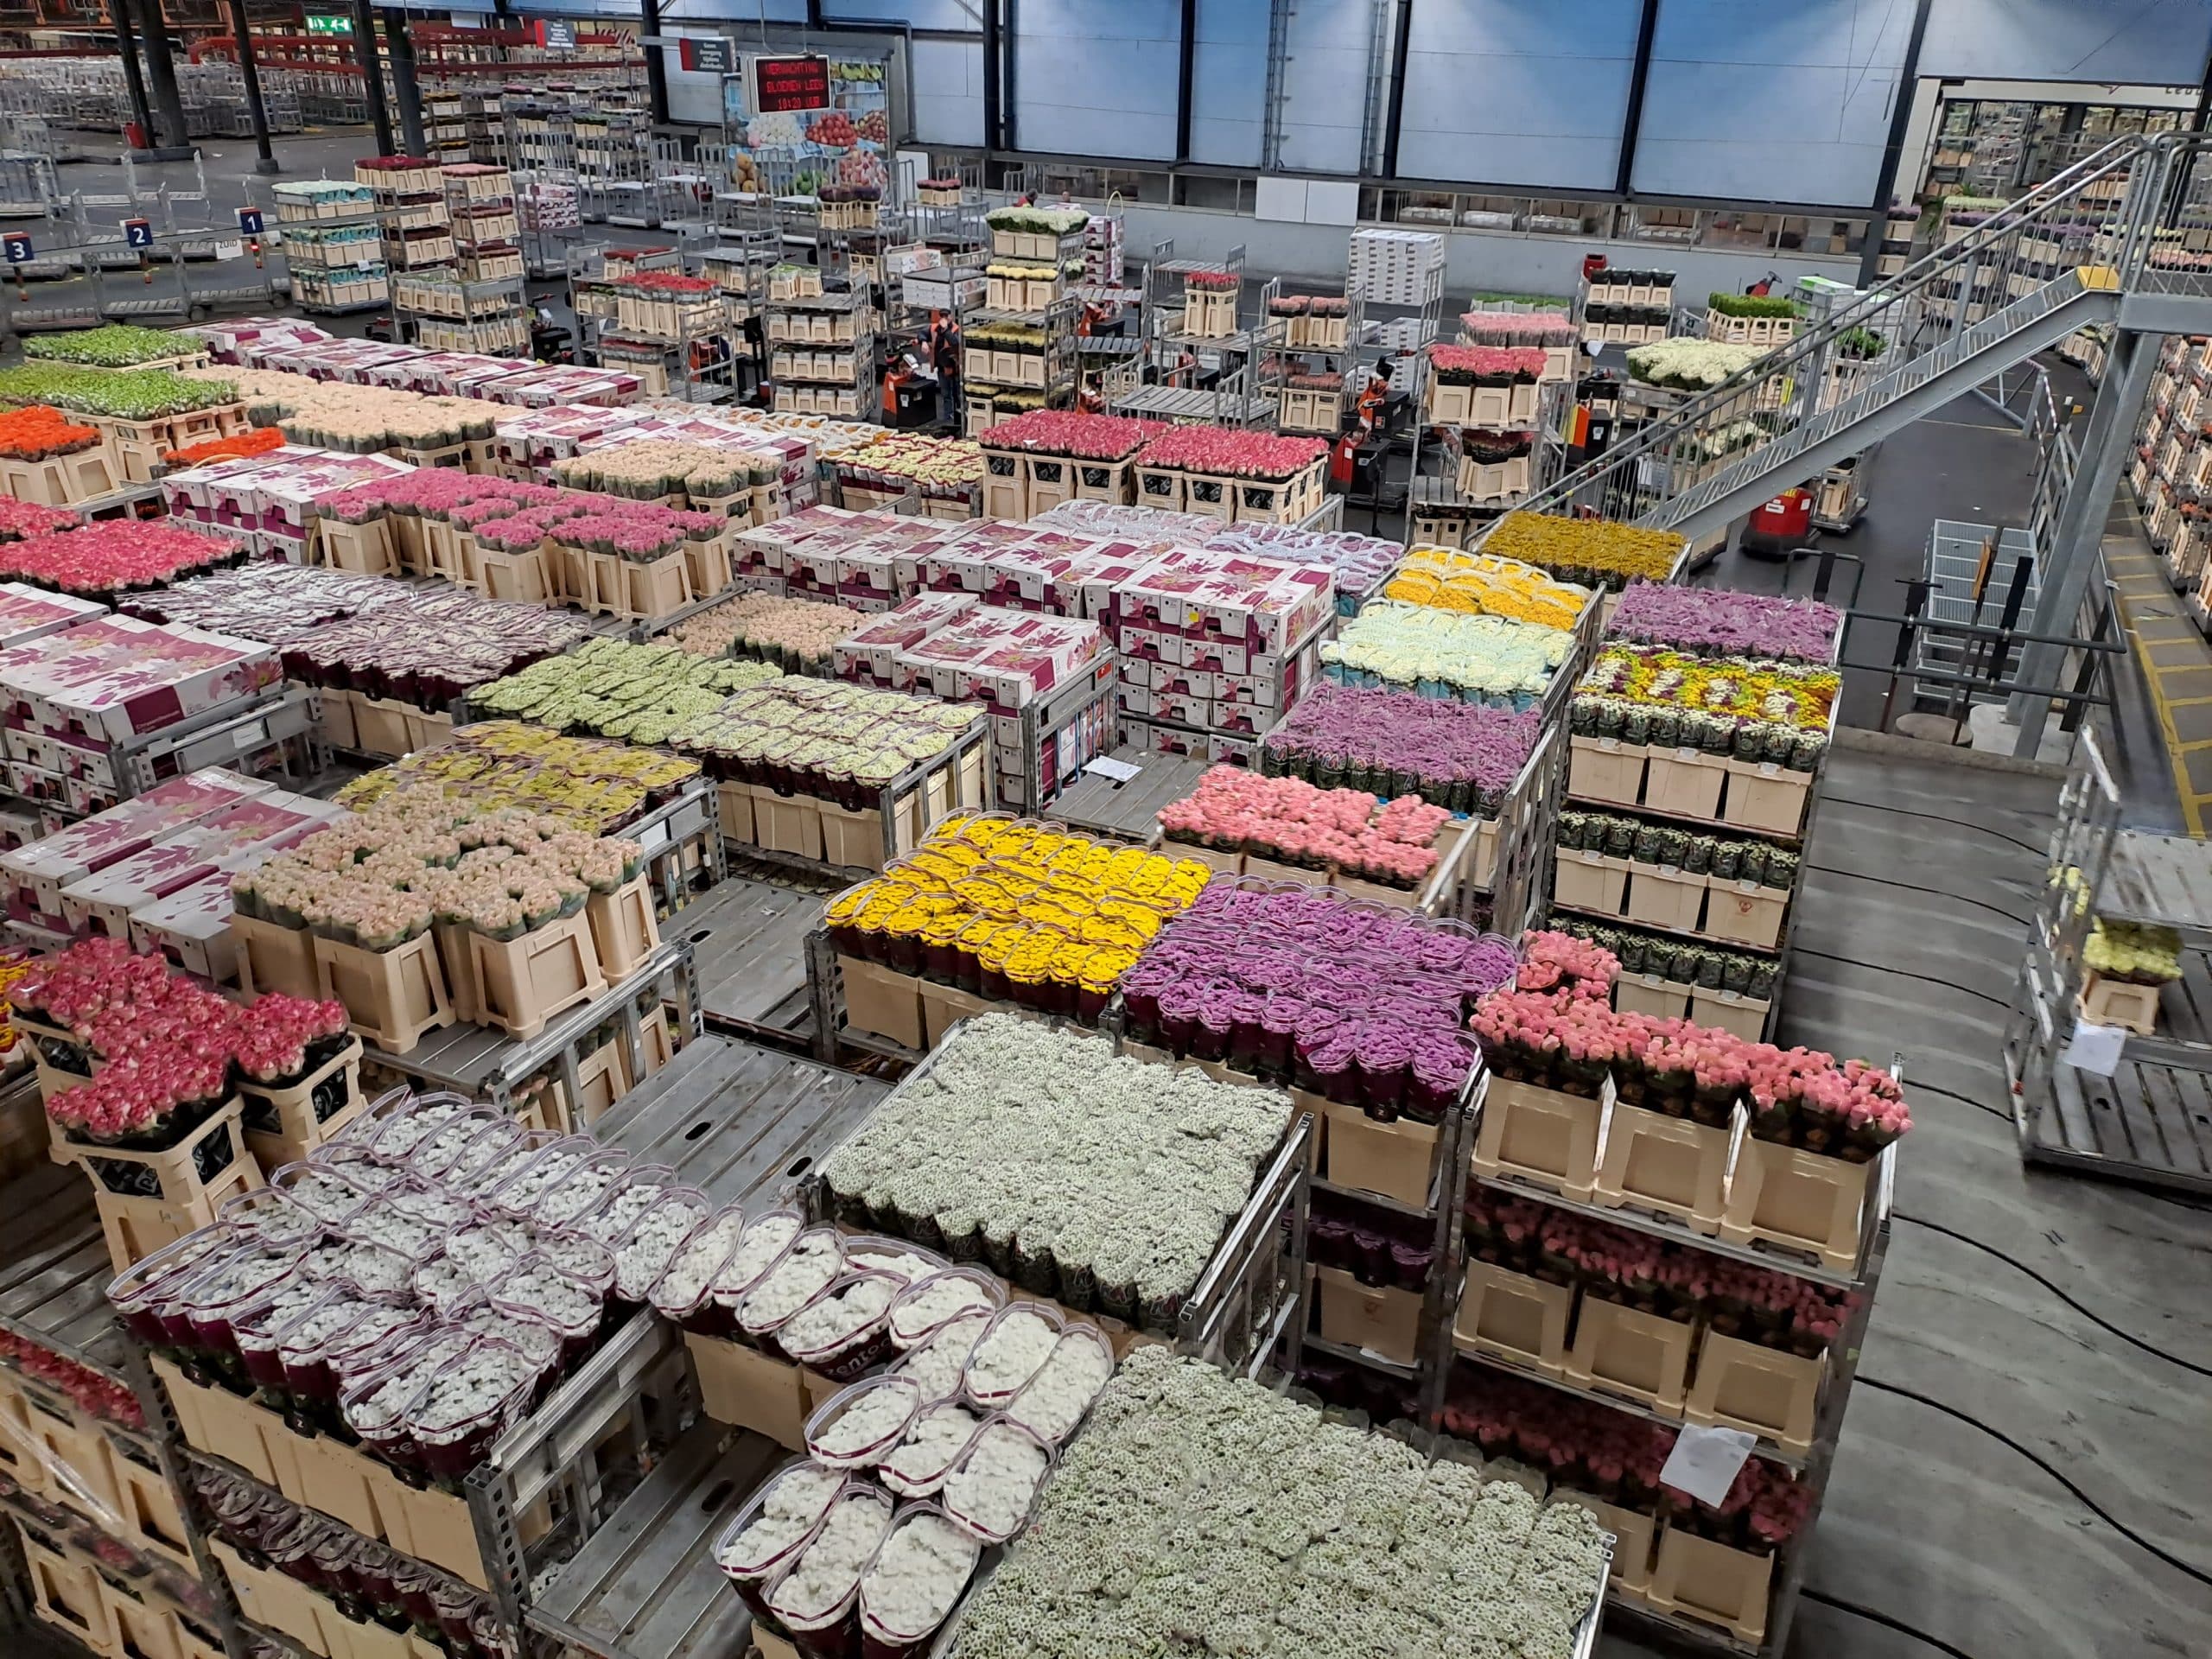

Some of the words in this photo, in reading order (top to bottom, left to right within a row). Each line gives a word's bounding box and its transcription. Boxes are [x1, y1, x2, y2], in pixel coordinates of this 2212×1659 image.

[247, 215, 257, 231] 1
[133, 227, 145, 244] 2
[12, 241, 25, 259] 3
